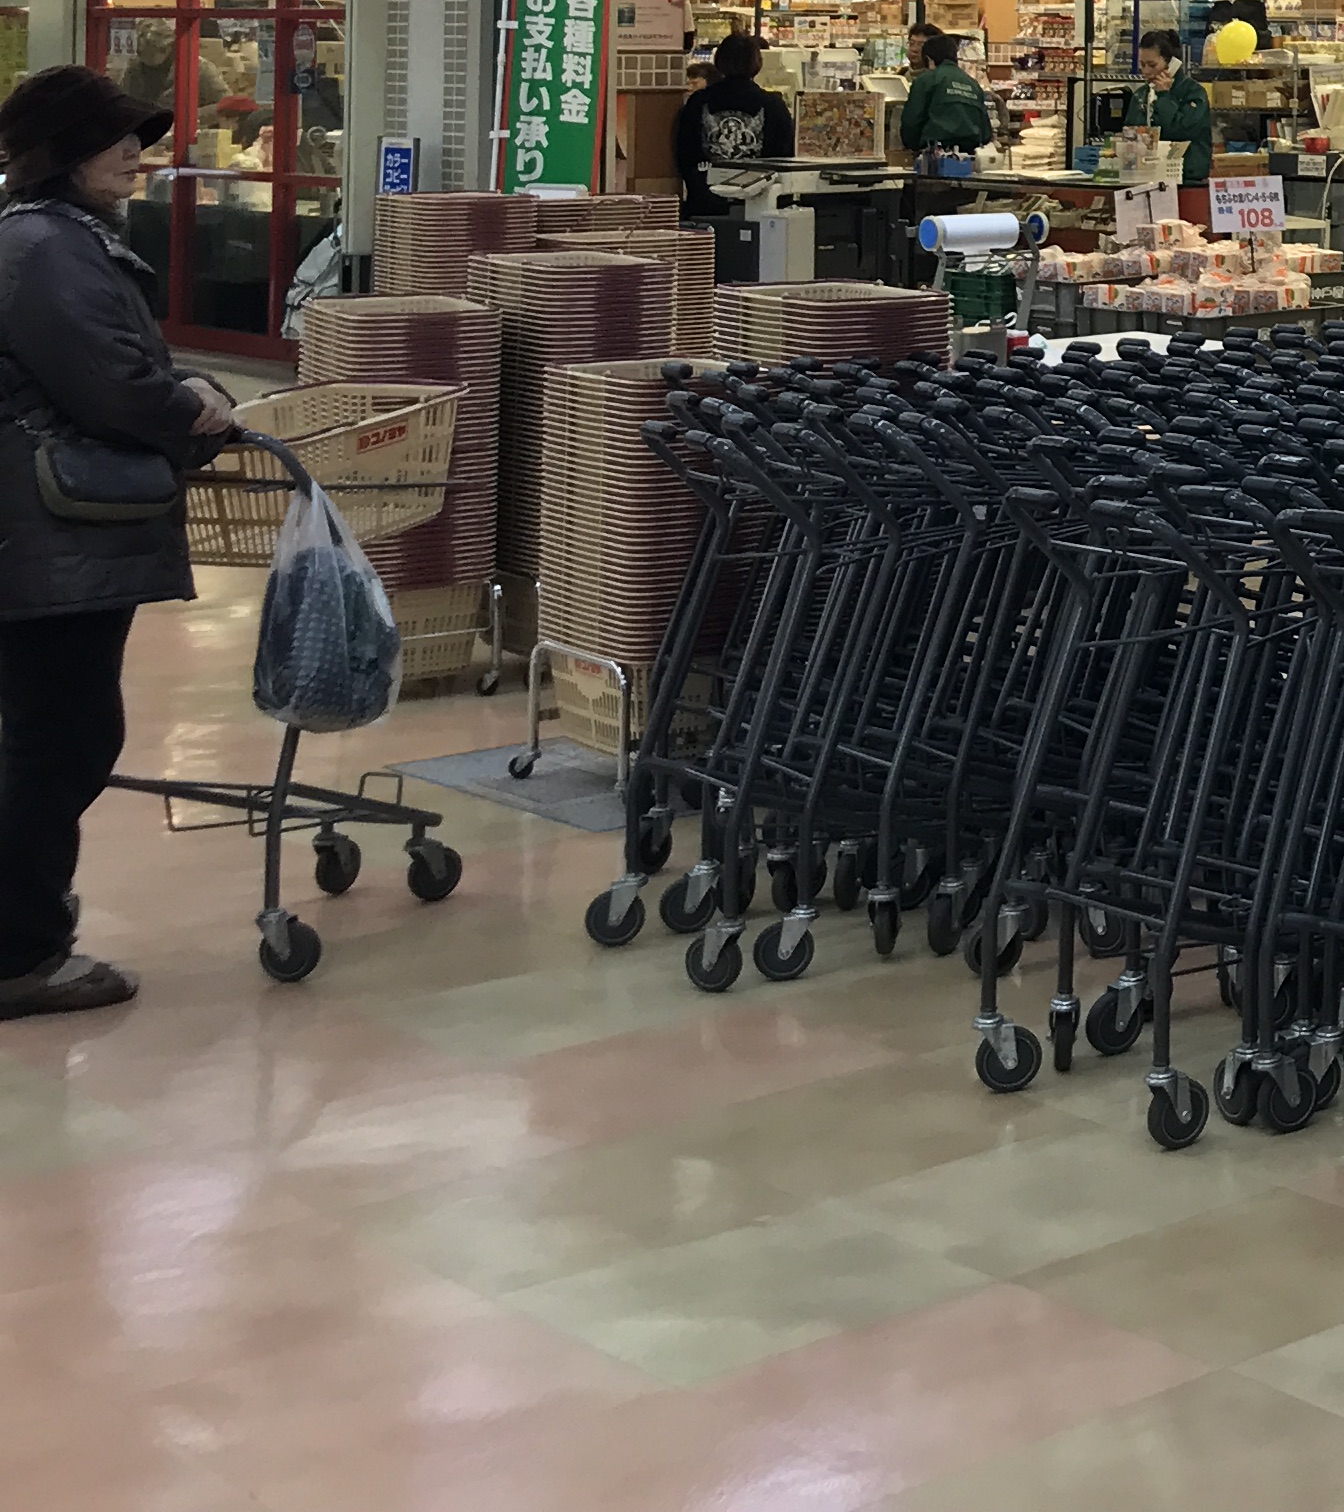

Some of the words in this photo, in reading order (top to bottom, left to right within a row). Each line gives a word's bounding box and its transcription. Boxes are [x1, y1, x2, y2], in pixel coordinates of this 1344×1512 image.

[386, 153, 409, 168] カラー
[385, 168, 408, 183] コピー
[1238, 208, 1274, 228] 108
